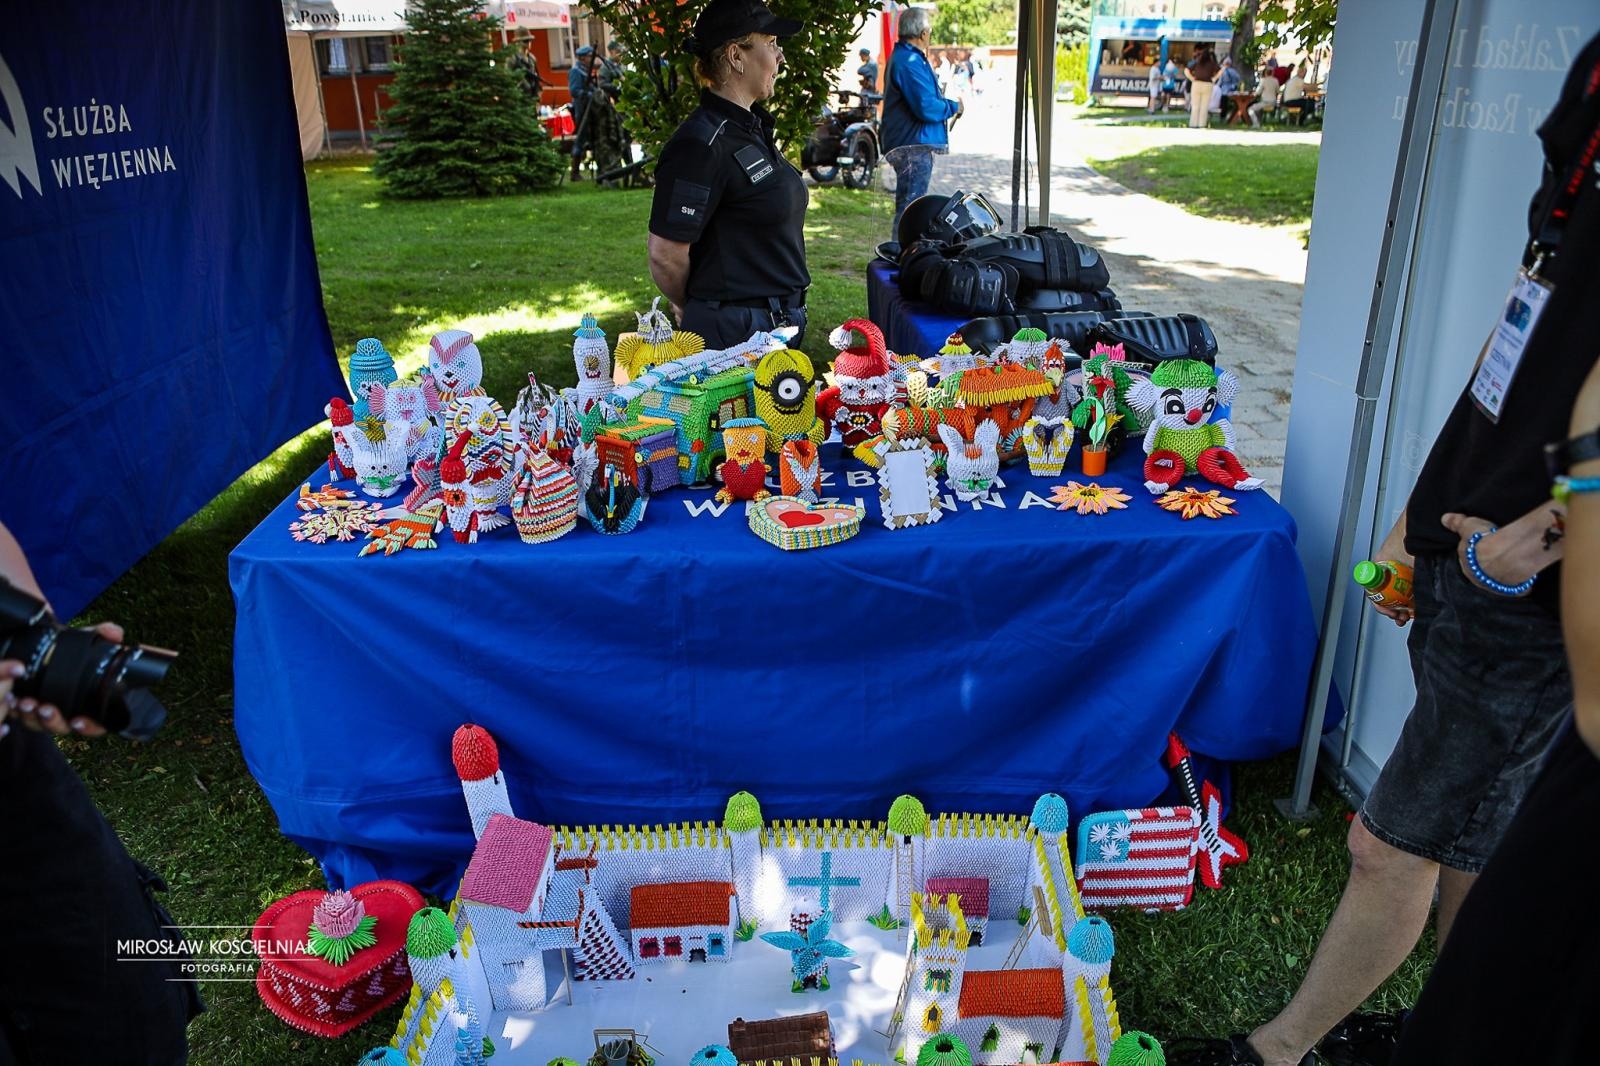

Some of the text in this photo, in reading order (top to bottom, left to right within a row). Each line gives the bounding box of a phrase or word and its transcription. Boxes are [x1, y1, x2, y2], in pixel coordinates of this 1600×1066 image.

[43, 98, 132, 139] SŁUŻBA
[51, 145, 177, 190] WIĘZIENNA
[681, 206, 695, 216] SW
